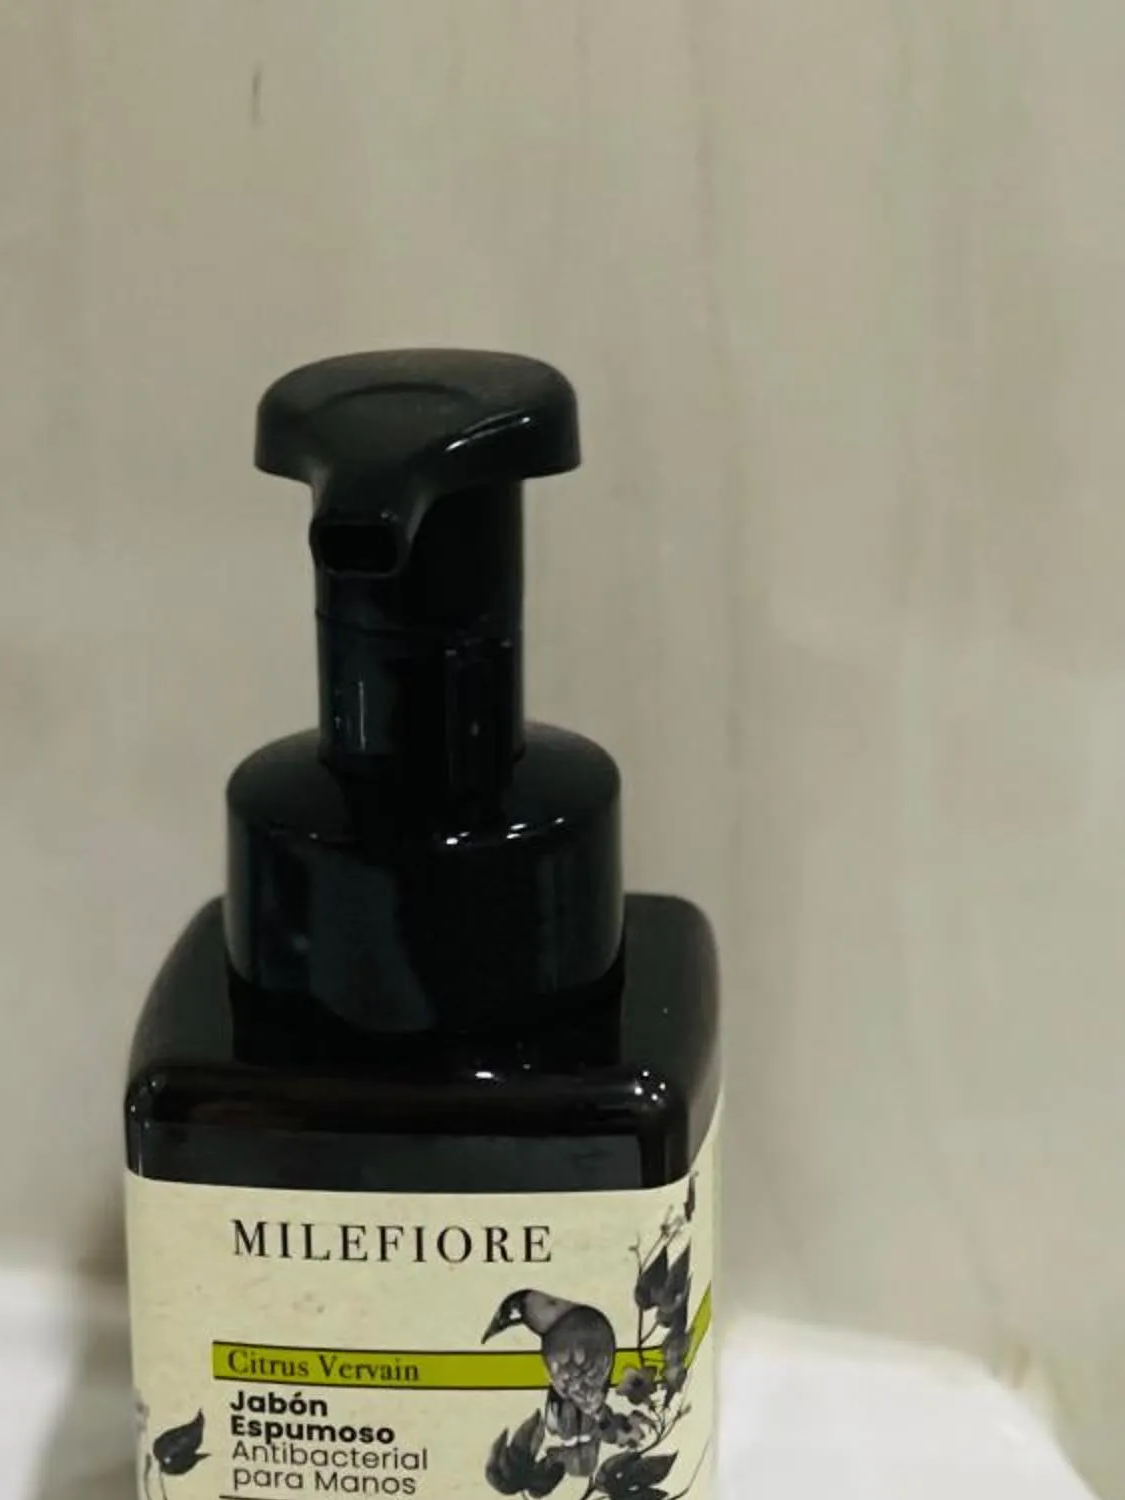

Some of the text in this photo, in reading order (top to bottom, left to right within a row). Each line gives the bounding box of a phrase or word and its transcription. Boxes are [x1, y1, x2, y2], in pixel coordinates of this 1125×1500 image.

[231, 1219, 552, 1263] MILEFIORE
[228, 1350, 420, 1381] Citrus Vervain
[230, 1391, 328, 1416] Jabón
[231, 1415, 395, 1444] Espumoso
[232, 1440, 428, 1470] Antibacterial
[233, 1468, 416, 1495] para Manos
